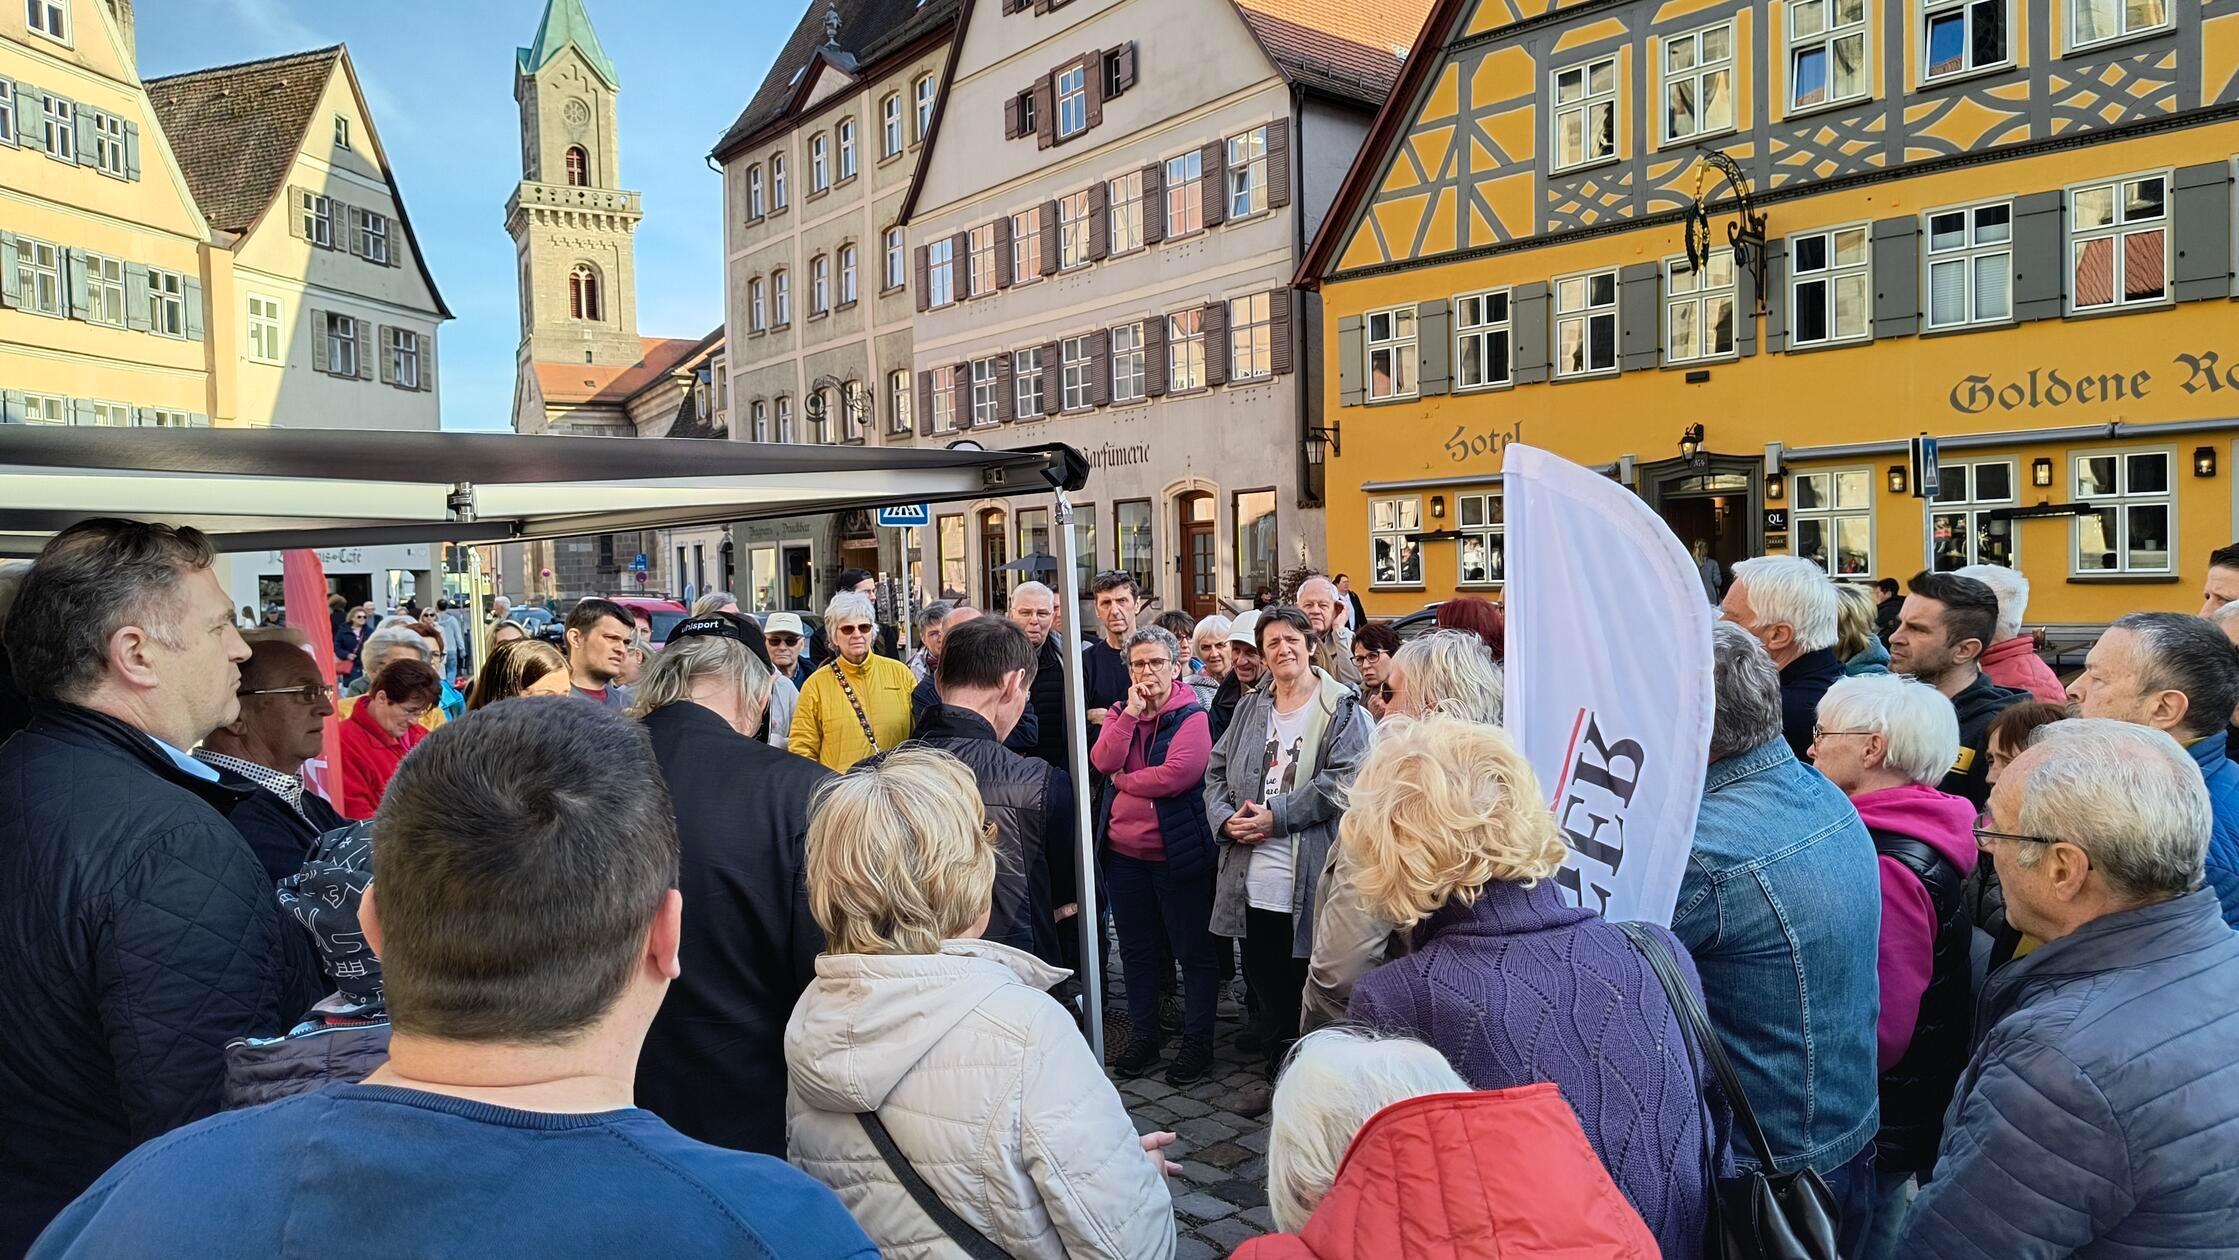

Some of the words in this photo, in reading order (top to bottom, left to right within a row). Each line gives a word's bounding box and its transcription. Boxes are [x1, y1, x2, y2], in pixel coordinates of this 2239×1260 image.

[1950, 367, 2152, 414] Goldene
[1444, 419, 1524, 462] Hotel
[1768, 514, 1783, 525] QL
[681, 620, 719, 633] uhlsport
